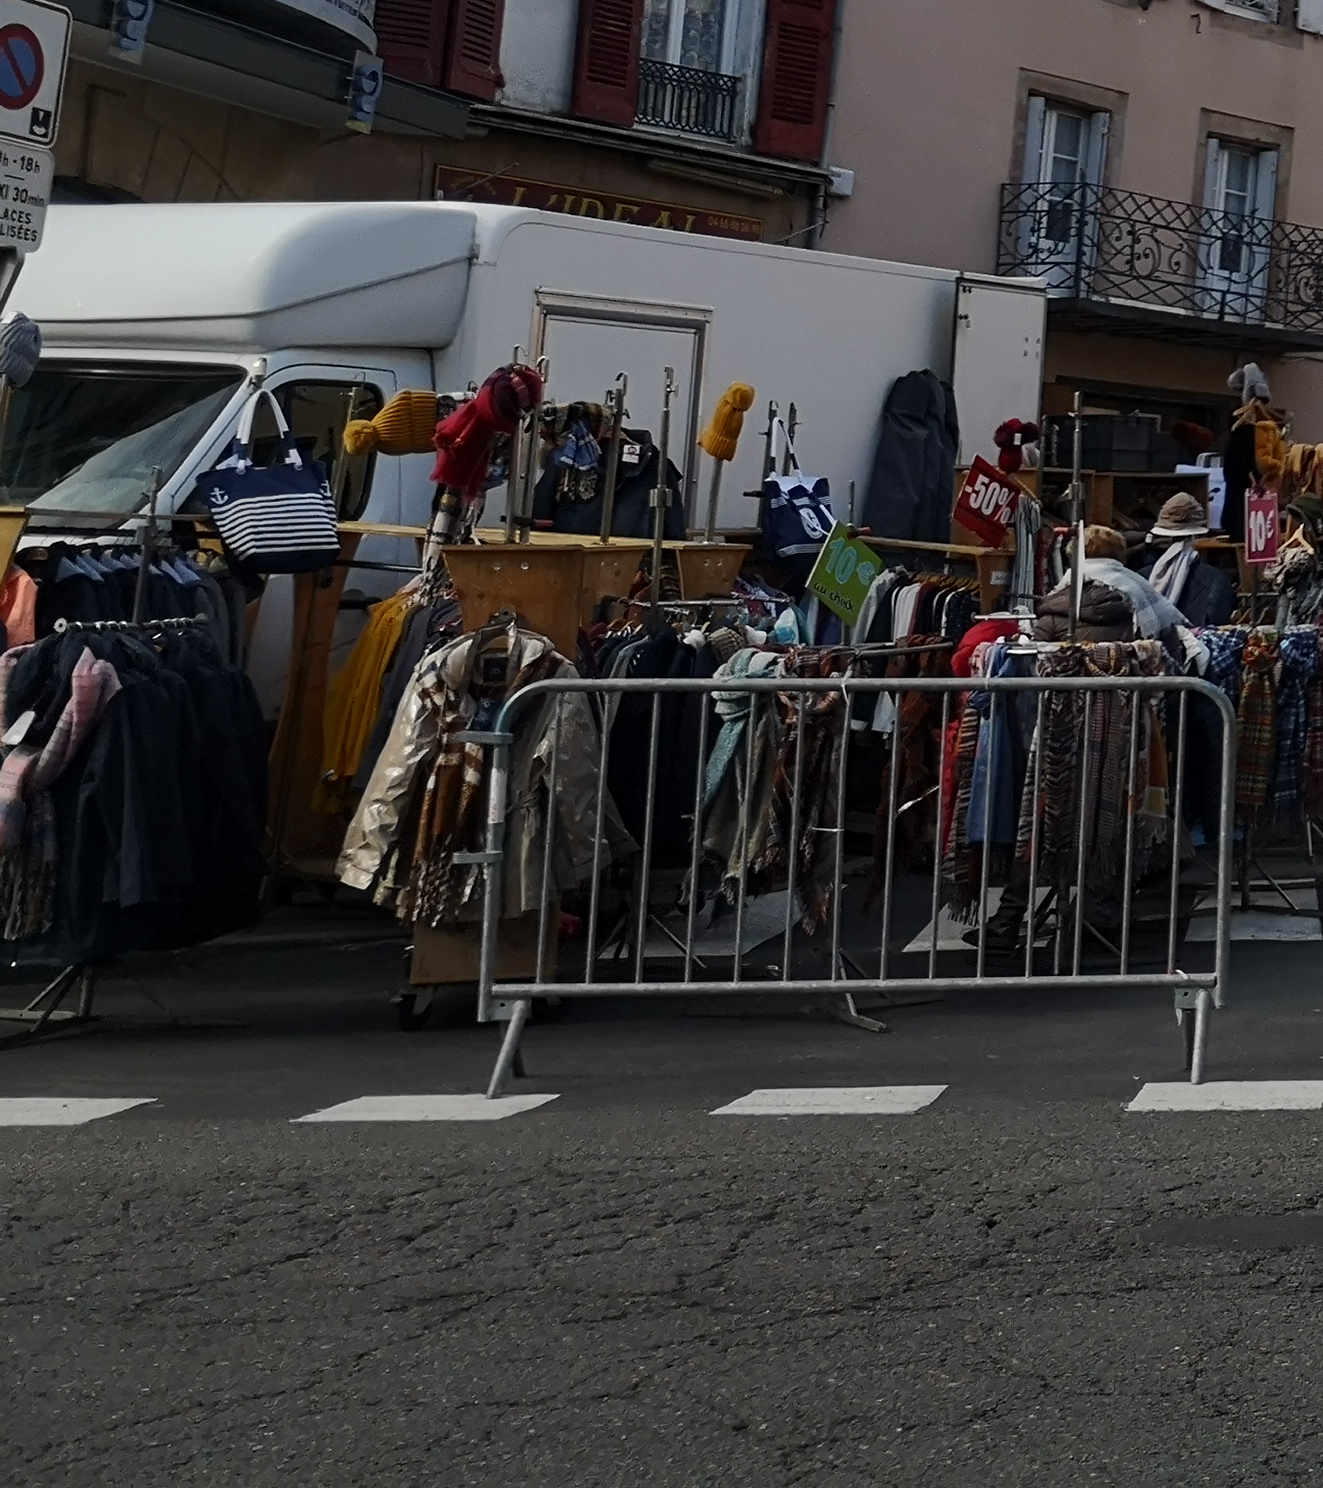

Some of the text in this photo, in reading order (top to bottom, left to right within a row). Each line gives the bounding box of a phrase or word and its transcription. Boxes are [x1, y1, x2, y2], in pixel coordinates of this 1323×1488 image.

[20, 155, 41, 173] 18h
[12, 186, 45, 207] 30min
[964, 473, 1016, 525] -50%
[813, 582, 856, 614] au choix
